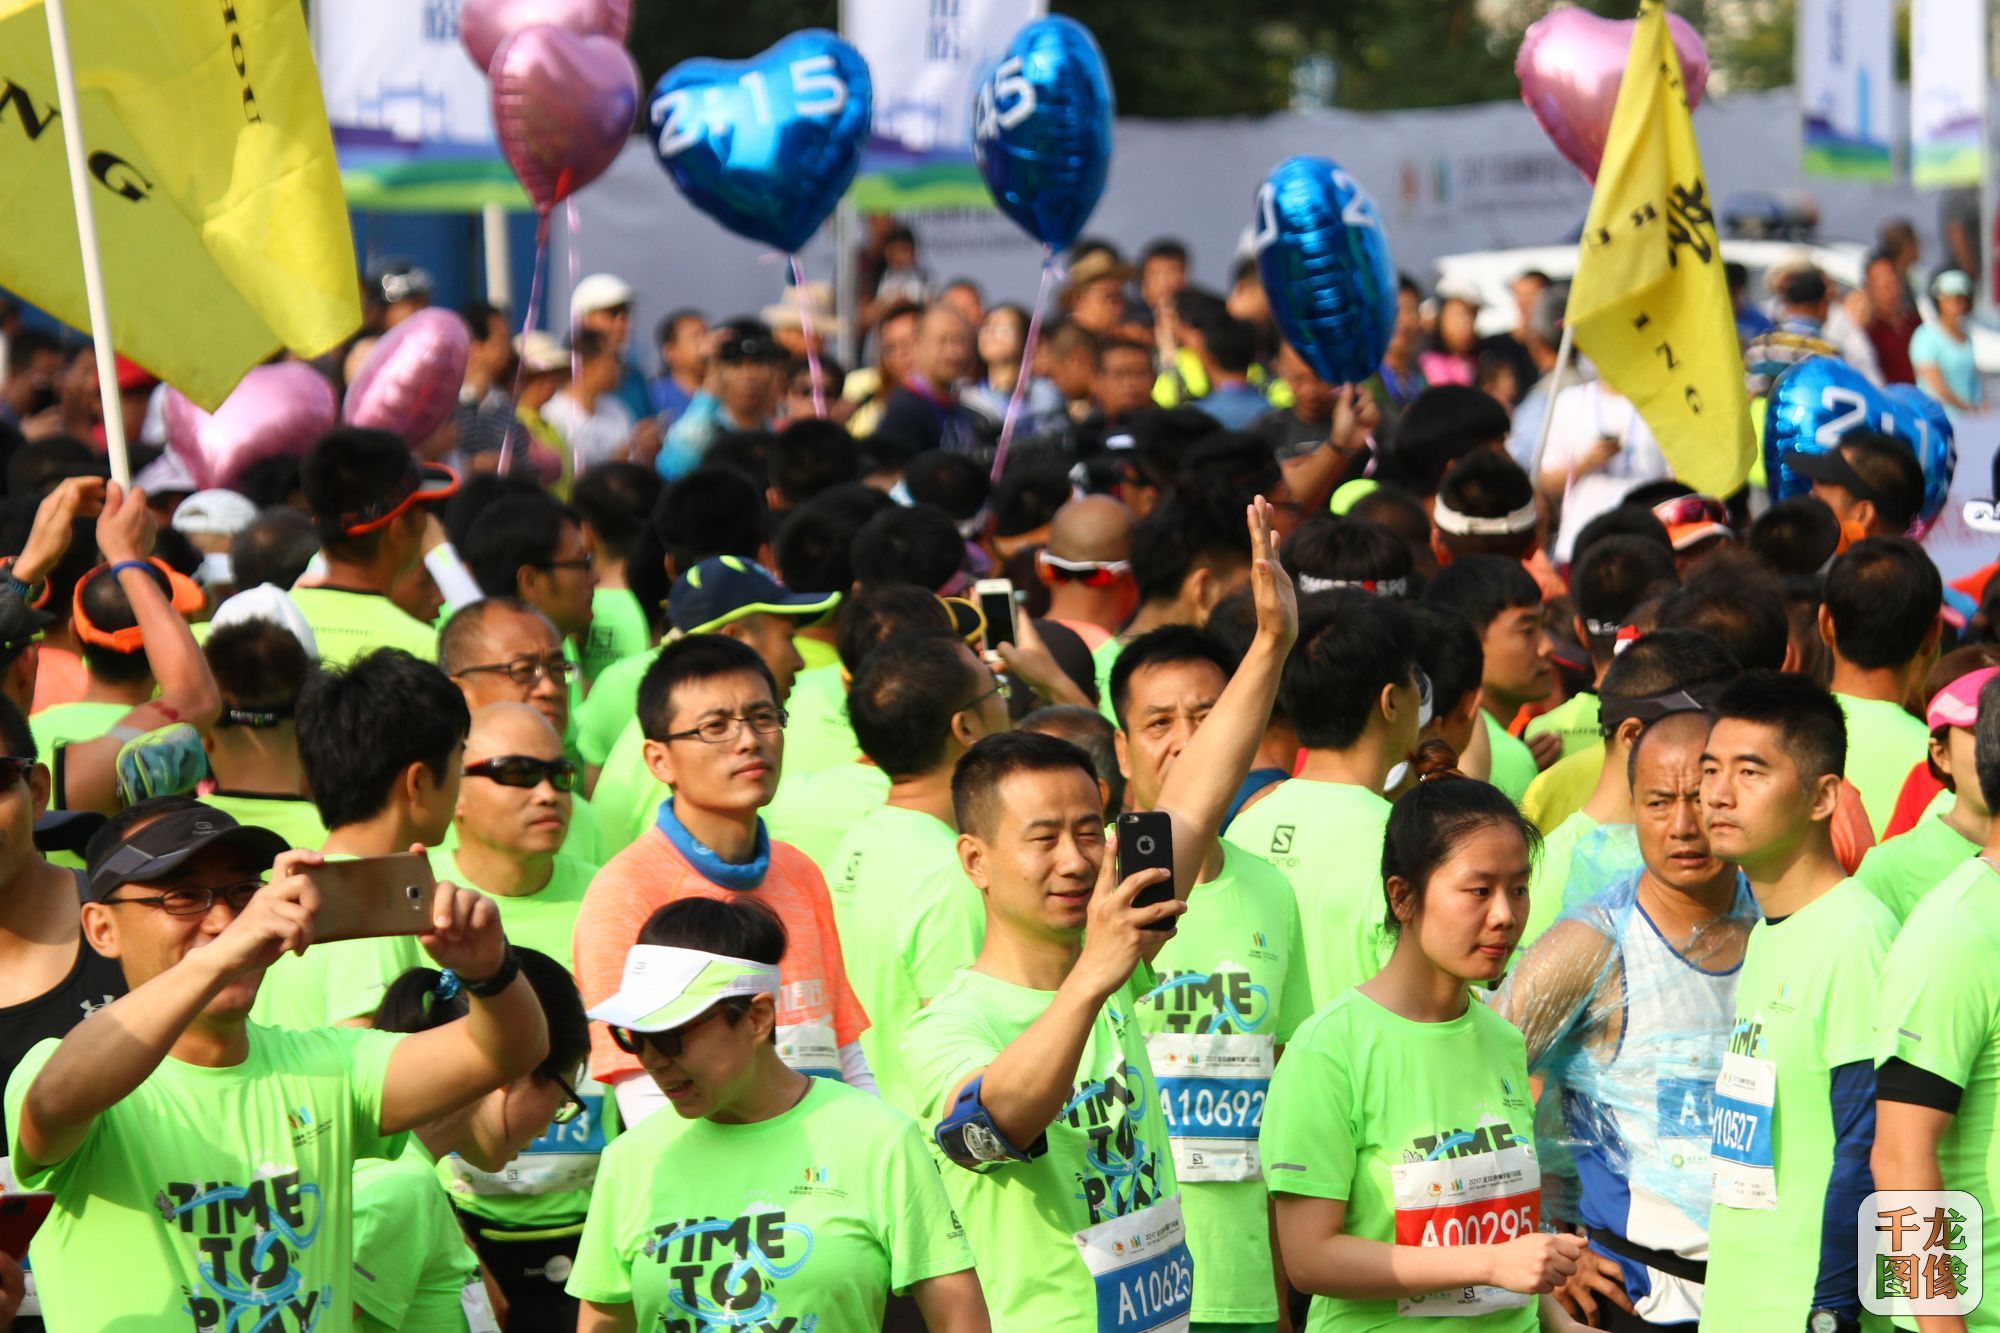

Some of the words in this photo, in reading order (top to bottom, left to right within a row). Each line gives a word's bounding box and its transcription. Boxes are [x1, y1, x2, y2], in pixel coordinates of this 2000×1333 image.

[1155, 970, 1252, 1014] TIME
[1160, 1088, 1266, 1128] A10692
[1413, 1123, 1517, 1161] TIME
[168, 1171, 304, 1234] TIME
[655, 1211, 786, 1263] TIME
[1421, 1206, 1533, 1247] A00295
[199, 1235, 289, 1288] TO
[670, 1262, 761, 1310] TO
